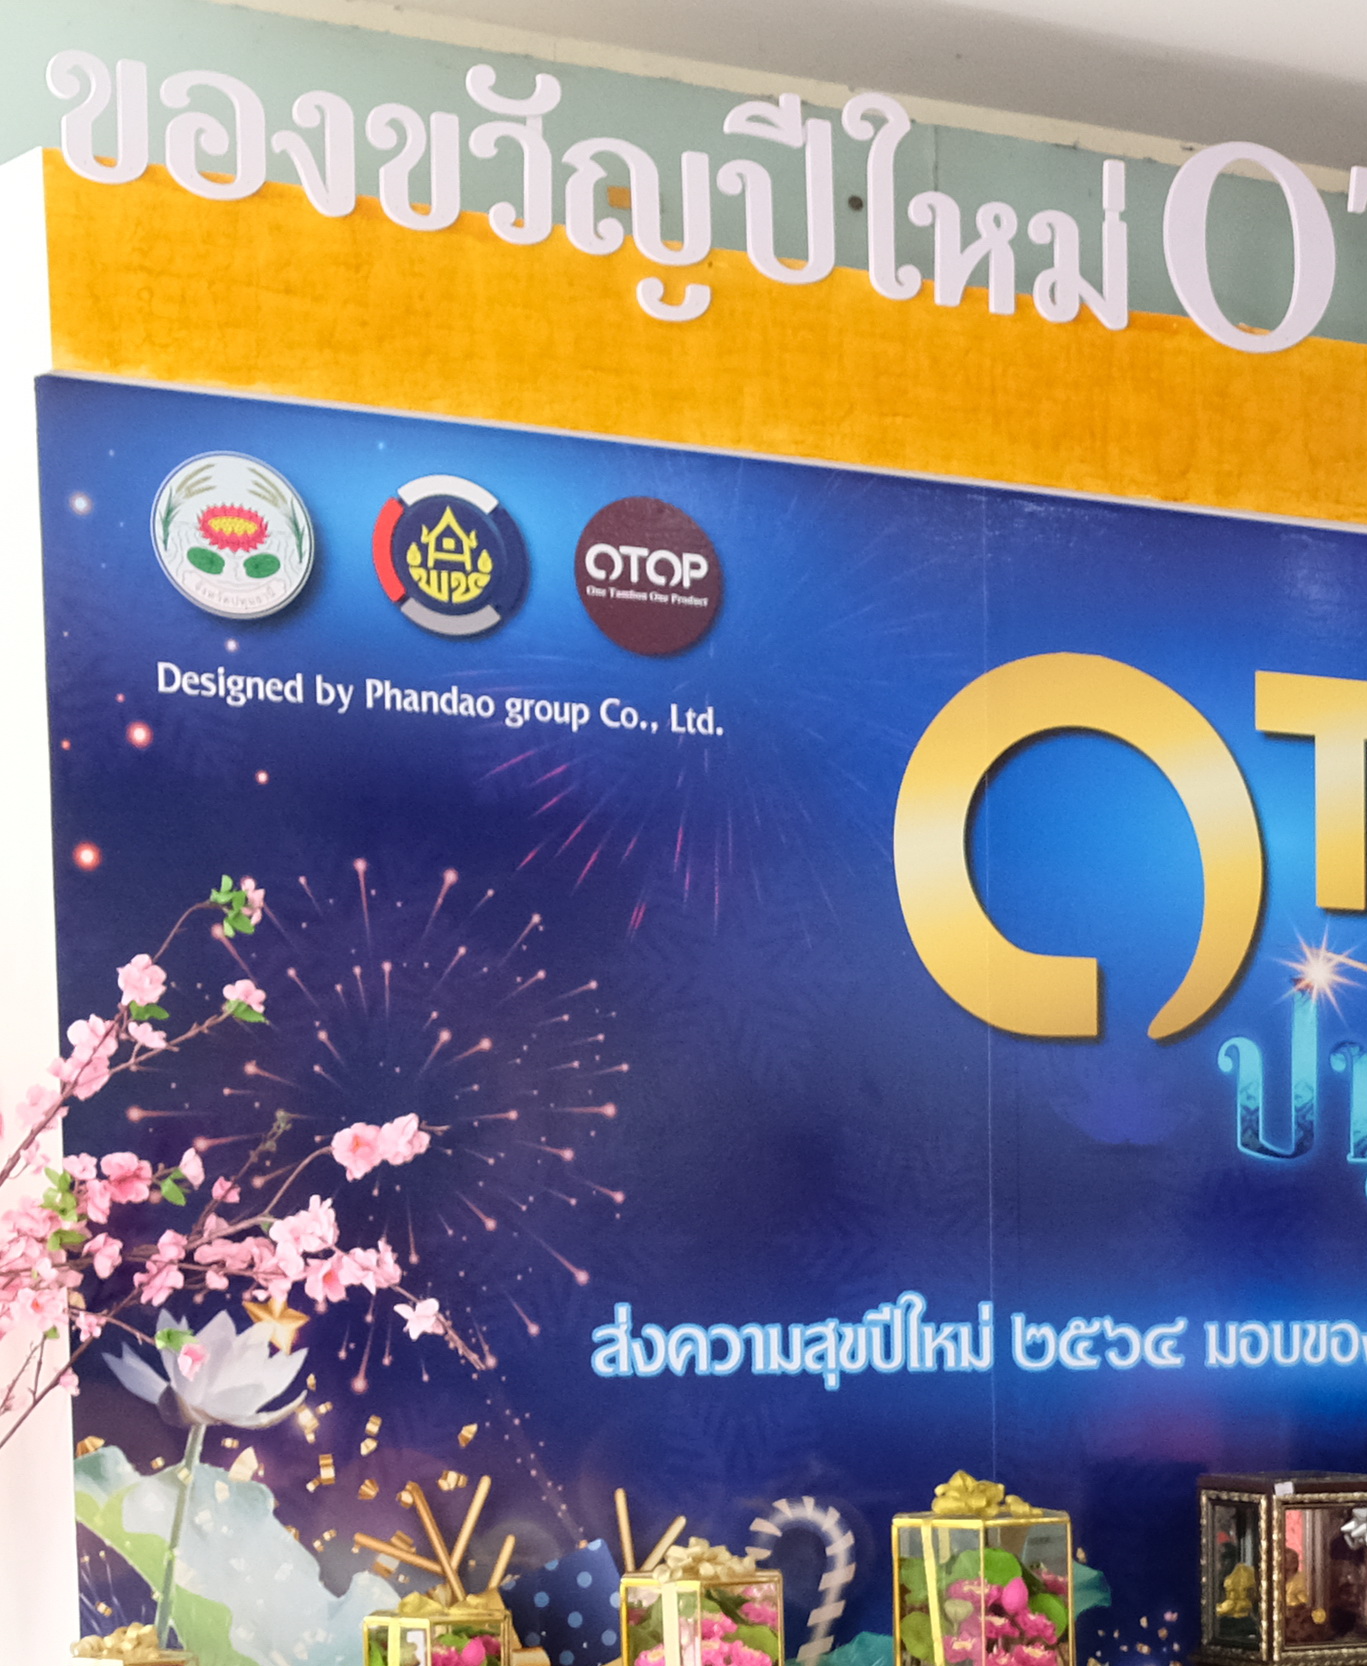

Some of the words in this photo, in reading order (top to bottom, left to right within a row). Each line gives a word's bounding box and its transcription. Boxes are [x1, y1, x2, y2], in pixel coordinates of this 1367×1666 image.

[46, 49, 1129, 330] ของขวัญปีใหม่
[585, 543, 709, 588] OTOP
[156, 661, 303, 706] Designed
[316, 674, 354, 713] by
[365, 679, 495, 718] Phandao
[505, 698, 590, 731] group
[600, 698, 659, 734] Co.,
[670, 704, 724, 737] Ltd.
[591, 1290, 994, 1391] ส่งความสุขปีใหม่
[1010, 1314, 1187, 1370] ๒๕๖๔
